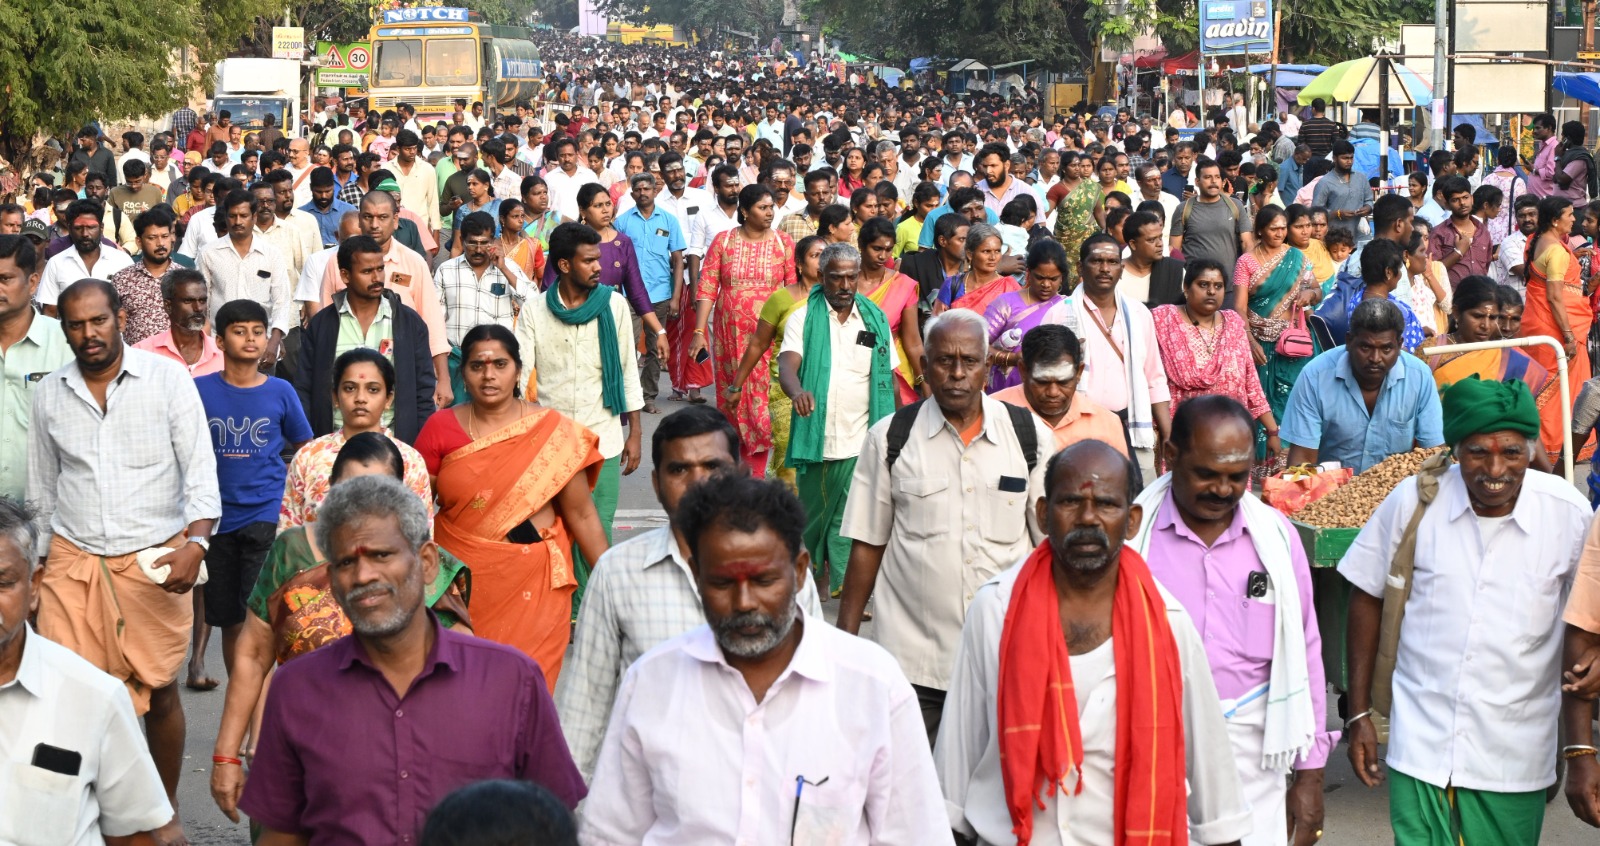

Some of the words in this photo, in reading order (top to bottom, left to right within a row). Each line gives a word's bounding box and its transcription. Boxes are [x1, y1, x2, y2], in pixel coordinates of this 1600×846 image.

[387, 8, 463, 22] NOTCH
[1205, 17, 1270, 39] aavin
[351, 53, 366, 63] 30
[25, 220, 45, 231] BRO
